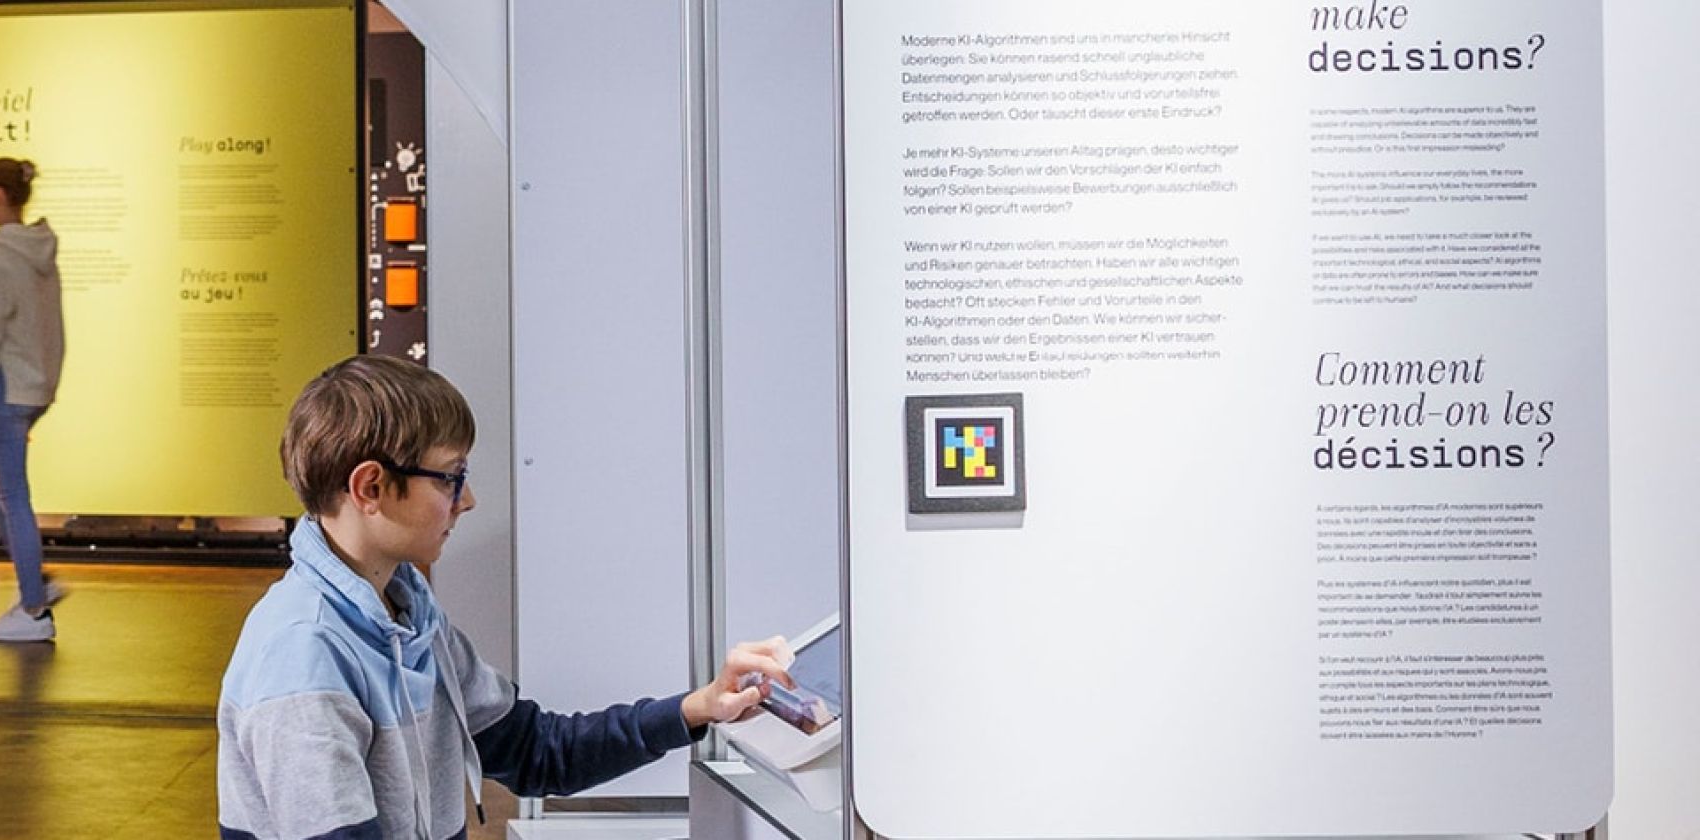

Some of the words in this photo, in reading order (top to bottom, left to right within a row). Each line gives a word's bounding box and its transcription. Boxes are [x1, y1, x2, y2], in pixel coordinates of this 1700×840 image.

[1311, 0, 1409, 30] make
[901, 34, 956, 46] Moderne
[957, 33, 1048, 48] KI-Algorithmen
[1076, 35, 1099, 44] uns
[1099, 33, 1112, 44] in
[1181, 32, 1230, 43] Hinsicht
[968, 53, 988, 64] Sie
[1037, 52, 1080, 63] rasend
[1082, 51, 1125, 63] schnell
[1128, 51, 1205, 65] unglaubliche
[1308, 33, 1547, 72] decisions?
[901, 71, 985, 86] Datenmengen
[987, 70, 1054, 85] analysieren
[1055, 70, 1078, 81] und
[1079, 69, 1197, 84] Schlussfolgerungen
[902, 90, 1002, 104] Entscheidungen
[1051, 91, 1067, 100] so
[1068, 88, 1115, 102] objektiv
[1117, 88, 1141, 99] und
[902, 109, 957, 123] getroffen
[1008, 108, 1039, 119] Oder
[1088, 107, 1125, 118] dieser
[1128, 107, 1159, 118] erste
[1161, 106, 1222, 118] Eindruck?
[216, 137, 272, 155] along!
[902, 147, 918, 159] Je
[918, 147, 949, 158] mehr
[950, 146, 1019, 160] KI-Systeme
[1150, 144, 1184, 155] desto
[1185, 143, 1239, 157] wichtiger
[903, 165, 929, 176] wird
[929, 165, 948, 176] die
[987, 164, 1024, 175] Sollen
[1026, 164, 1042, 175] wir
[1045, 164, 1068, 175] den
[1143, 163, 1163, 174] der
[1165, 163, 1178, 174] KI
[1179, 162, 1222, 174] einfach
[903, 184, 946, 198] folgen?
[948, 183, 985, 195] Sollen
[1072, 182, 1155, 196] Bewerbungen
[904, 205, 927, 214] von
[927, 202, 957, 214] einer
[960, 202, 973, 213] KI
[1020, 201, 1073, 213] werden?
[904, 240, 939, 252] Wenn
[940, 240, 957, 251] wir
[960, 240, 973, 251] KI
[974, 240, 1015, 251] nutzen
[1106, 238, 1124, 249] wir
[1126, 238, 1145, 249] die
[904, 259, 928, 271] und
[974, 260, 1023, 272] genauer
[1096, 257, 1137, 268] Haben
[1138, 256, 1156, 268] wir
[1158, 256, 1179, 267] alle
[1181, 255, 1240, 270] wichtigen
[1005, 276, 1063, 288] ethischen
[1064, 276, 1087, 287] und
[1088, 275, 1193, 289] gesellschaftlichen
[1194, 274, 1243, 288] Aspekte
[904, 296, 963, 308] bedacht?
[964, 296, 985, 307] Oft
[987, 295, 1036, 307] stecken
[1038, 295, 1075, 306] Fehler
[1078, 295, 1102, 306] und
[1104, 294, 1163, 306] Vorurteile
[1165, 294, 1177, 305] in
[1178, 294, 1202, 305] den
[904, 314, 996, 328] KI-Algorithmen
[997, 314, 1025, 325] oder
[1027, 314, 1051, 325] den
[1093, 313, 1117, 324] Wie
[1165, 313, 1183, 324] wir
[1185, 312, 1226, 323] sicher-
[950, 333, 980, 344] dass
[982, 333, 1000, 344] wir
[1003, 332, 1027, 344] den
[1028, 332, 1105, 346] Ergebnissen
[1108, 331, 1138, 343] einer
[1140, 331, 1154, 342] KI
[1156, 331, 1215, 342] vertrauen
[906, 369, 970, 381] Menschen
[1039, 367, 1091, 379] bleiben?
[1315, 351, 1488, 386] Comment
[1313, 391, 1491, 437] prend-on
[1503, 389, 1555, 426] les
[1313, 434, 1525, 469] décisions
